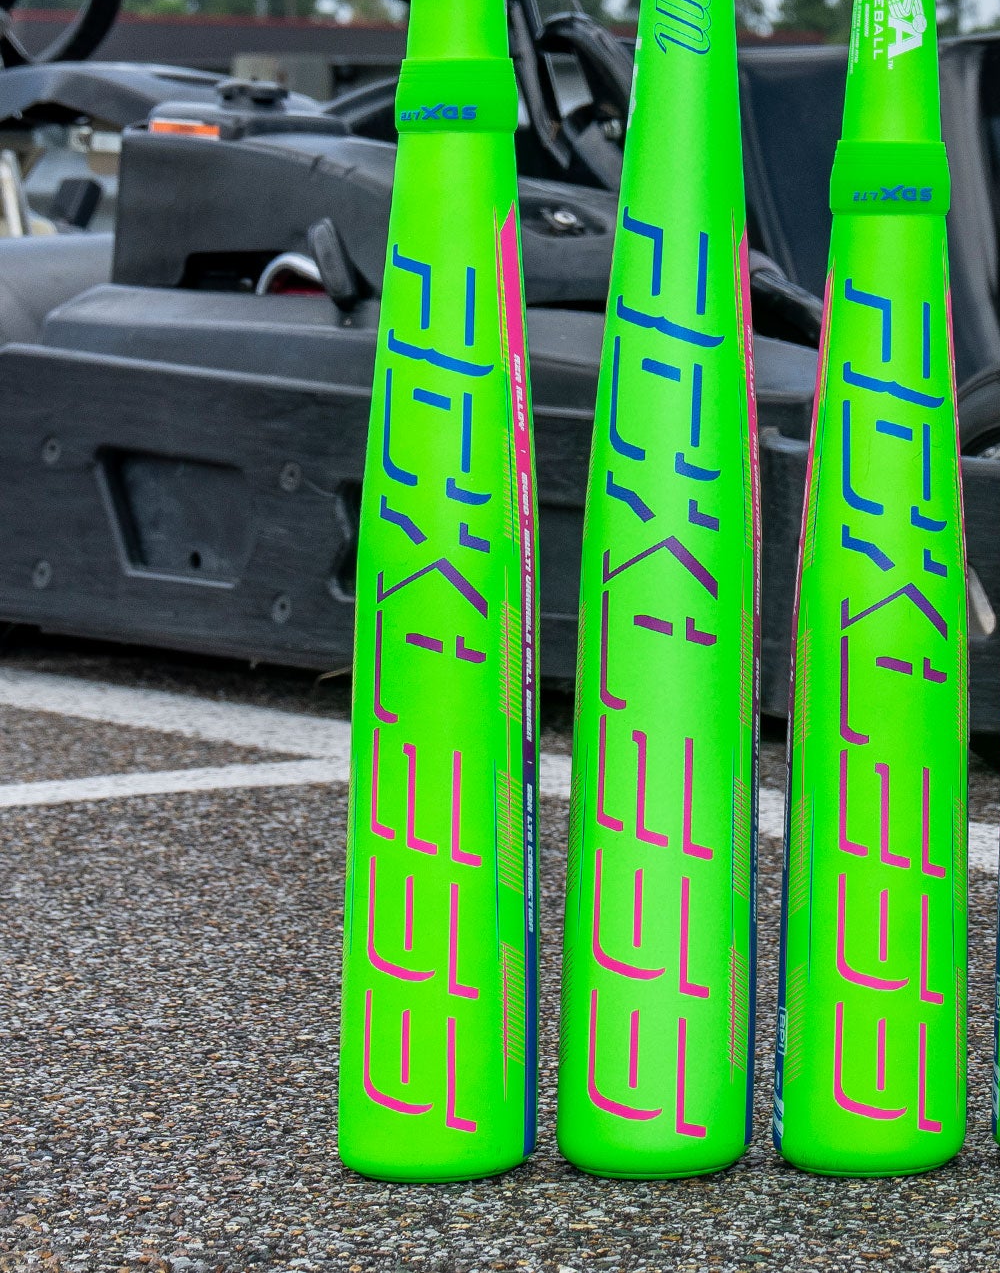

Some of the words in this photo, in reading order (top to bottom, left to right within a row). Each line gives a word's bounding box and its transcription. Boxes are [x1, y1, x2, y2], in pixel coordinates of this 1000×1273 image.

[400, 111, 420, 121] LTE
[421, 103, 478, 120] SDX
[852, 191, 878, 201] LTE
[880, 184, 932, 202] SDX
[516, 385, 524, 431] ALLOY
